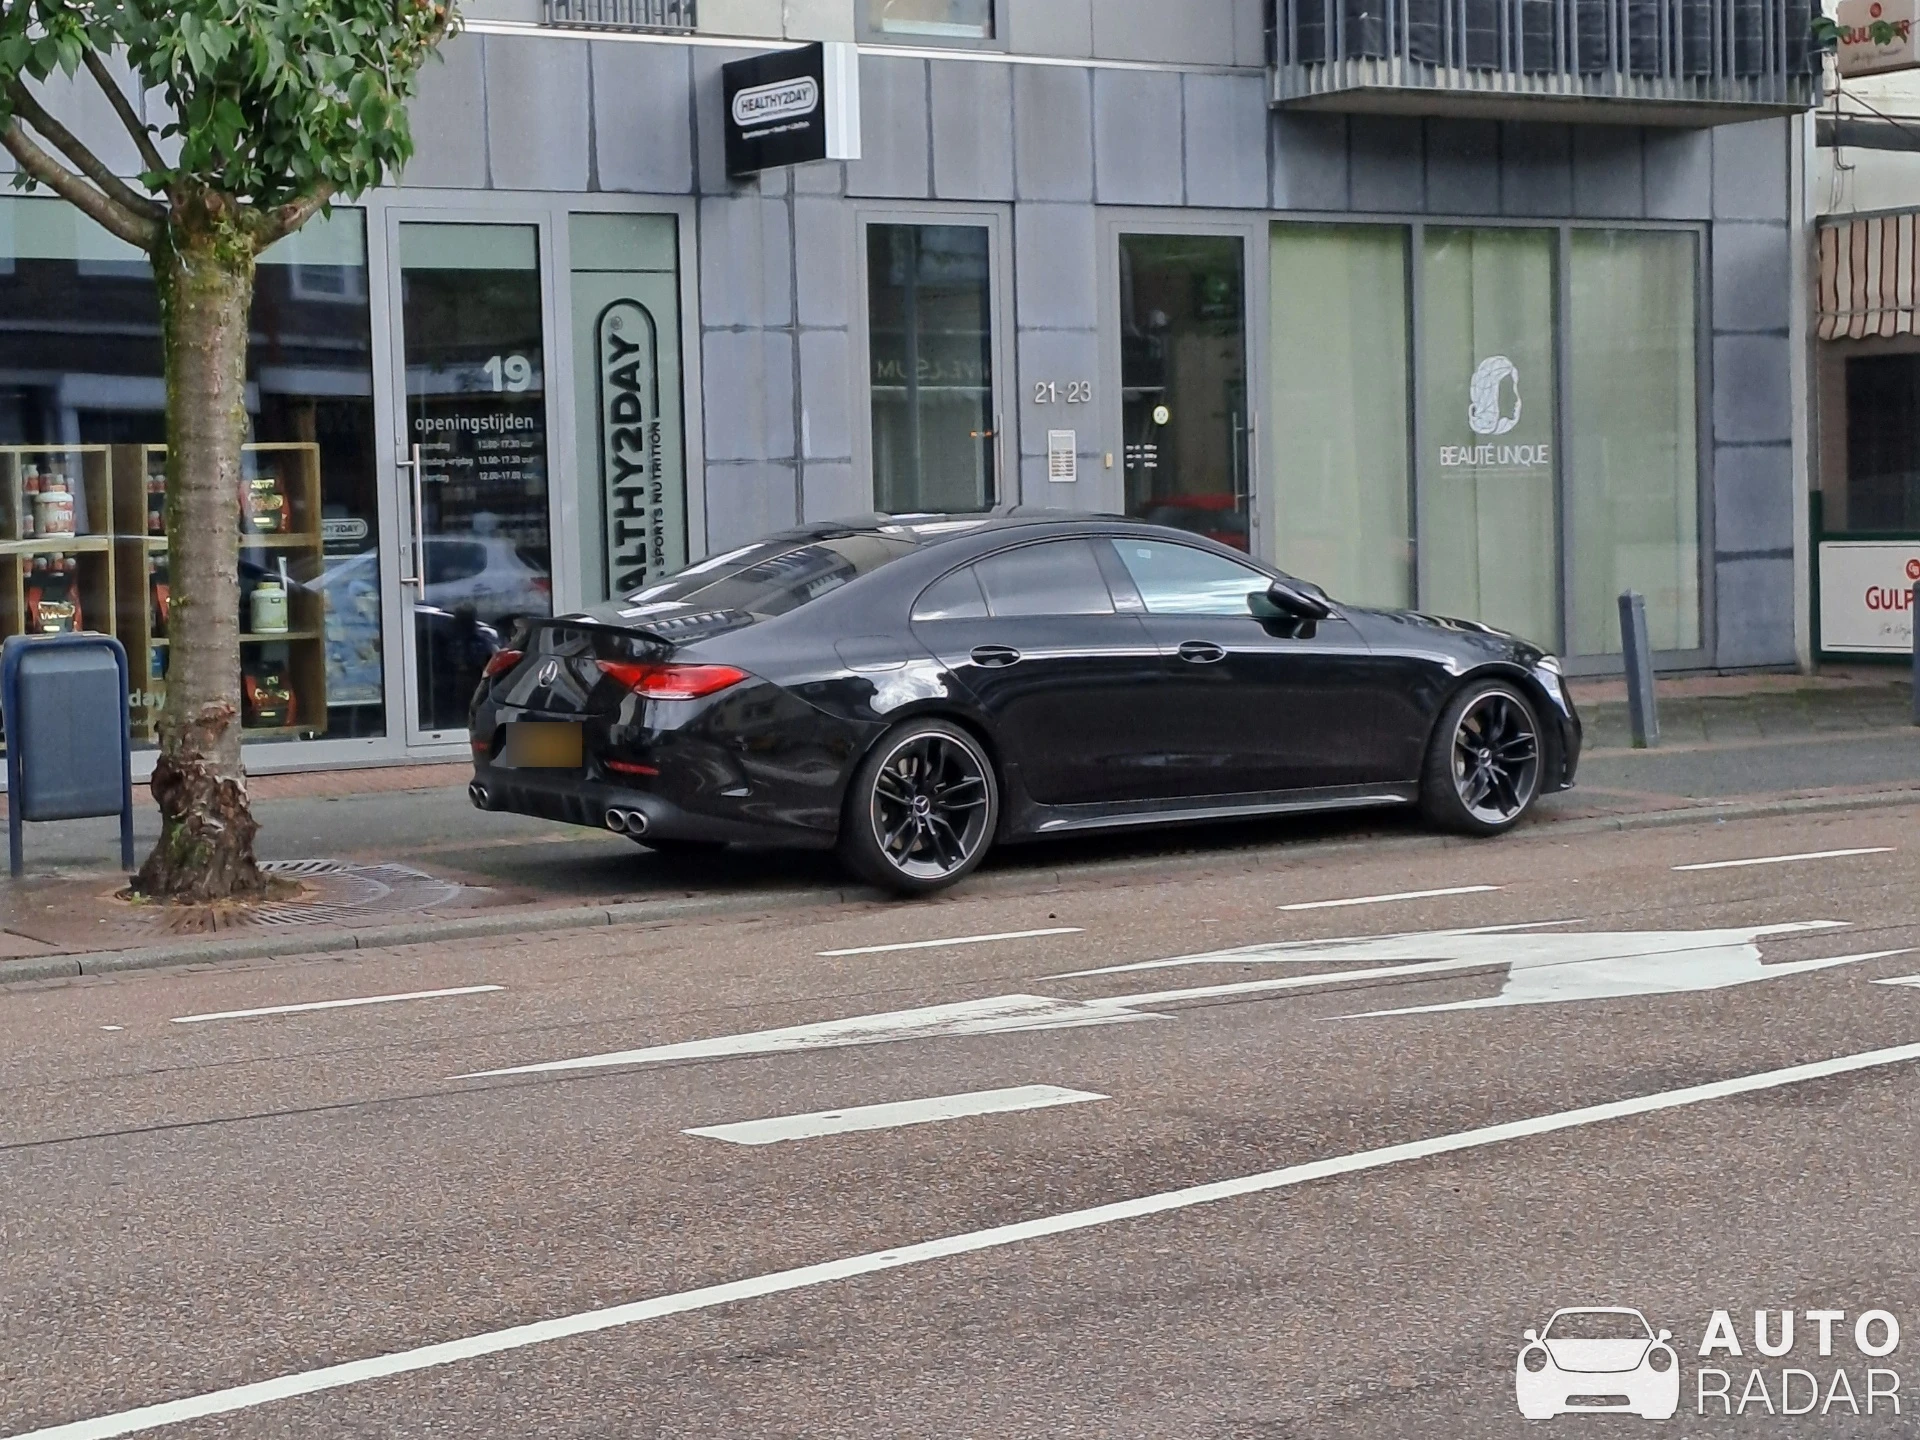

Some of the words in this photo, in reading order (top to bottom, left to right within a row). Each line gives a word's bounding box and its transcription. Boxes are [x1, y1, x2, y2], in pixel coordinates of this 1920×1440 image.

[741, 88, 809, 113] HEALTHY2DAY
[482, 355, 532, 393] 19
[415, 413, 534, 434] openingstijden
[608, 333, 647, 592] ALTHY2DAY
[650, 421, 663, 504] NUTRITION
[1440, 443, 1495, 466] BEAUTÉ
[653, 508, 665, 567] SPORTS
[1865, 586, 1914, 610] GULP
